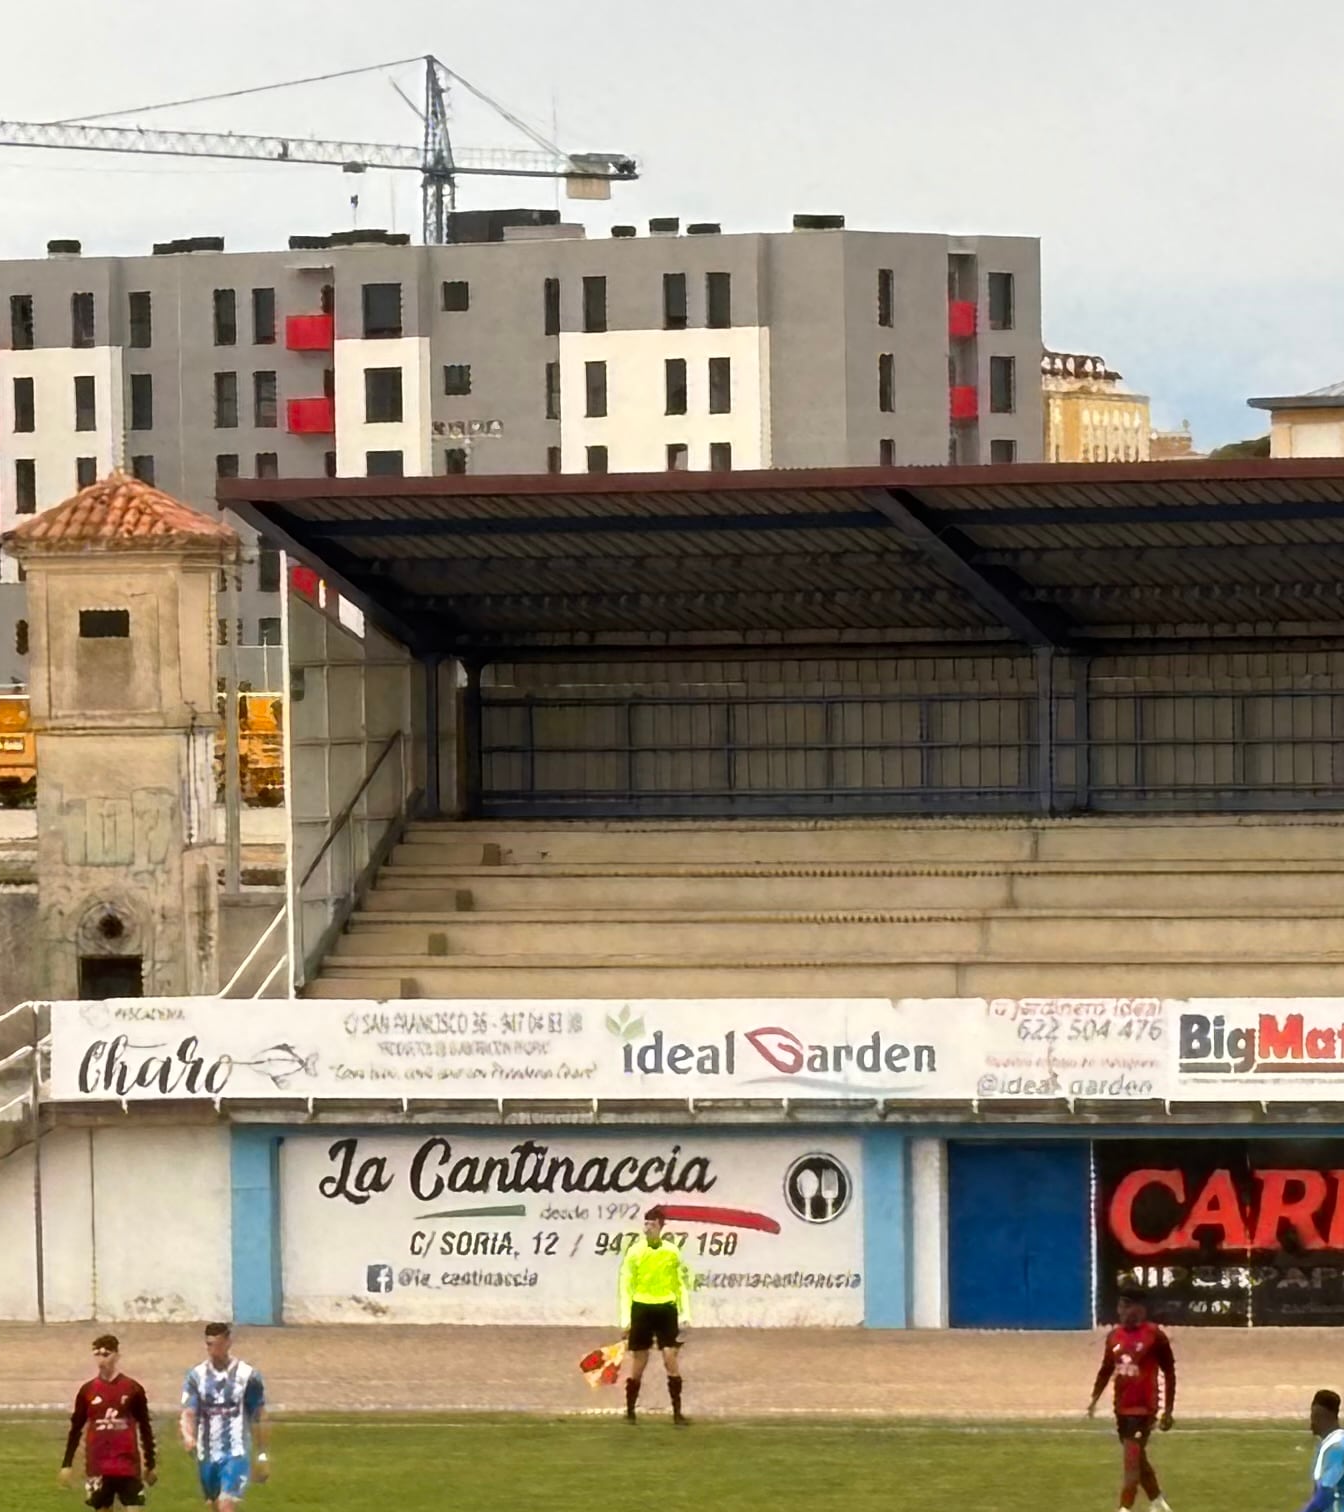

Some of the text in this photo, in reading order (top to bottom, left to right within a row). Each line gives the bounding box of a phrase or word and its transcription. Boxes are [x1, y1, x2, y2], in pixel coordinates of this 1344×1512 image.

[623, 1026, 937, 1075] ideal Garden
[1017, 1017, 1163, 1041] 622 504 476
[78, 1034, 233, 1096] Charo
[318, 1137, 718, 1205] La Cantinaccia
[533, 1232, 558, 1256] 12
[594, 1232, 640, 1256] 947
